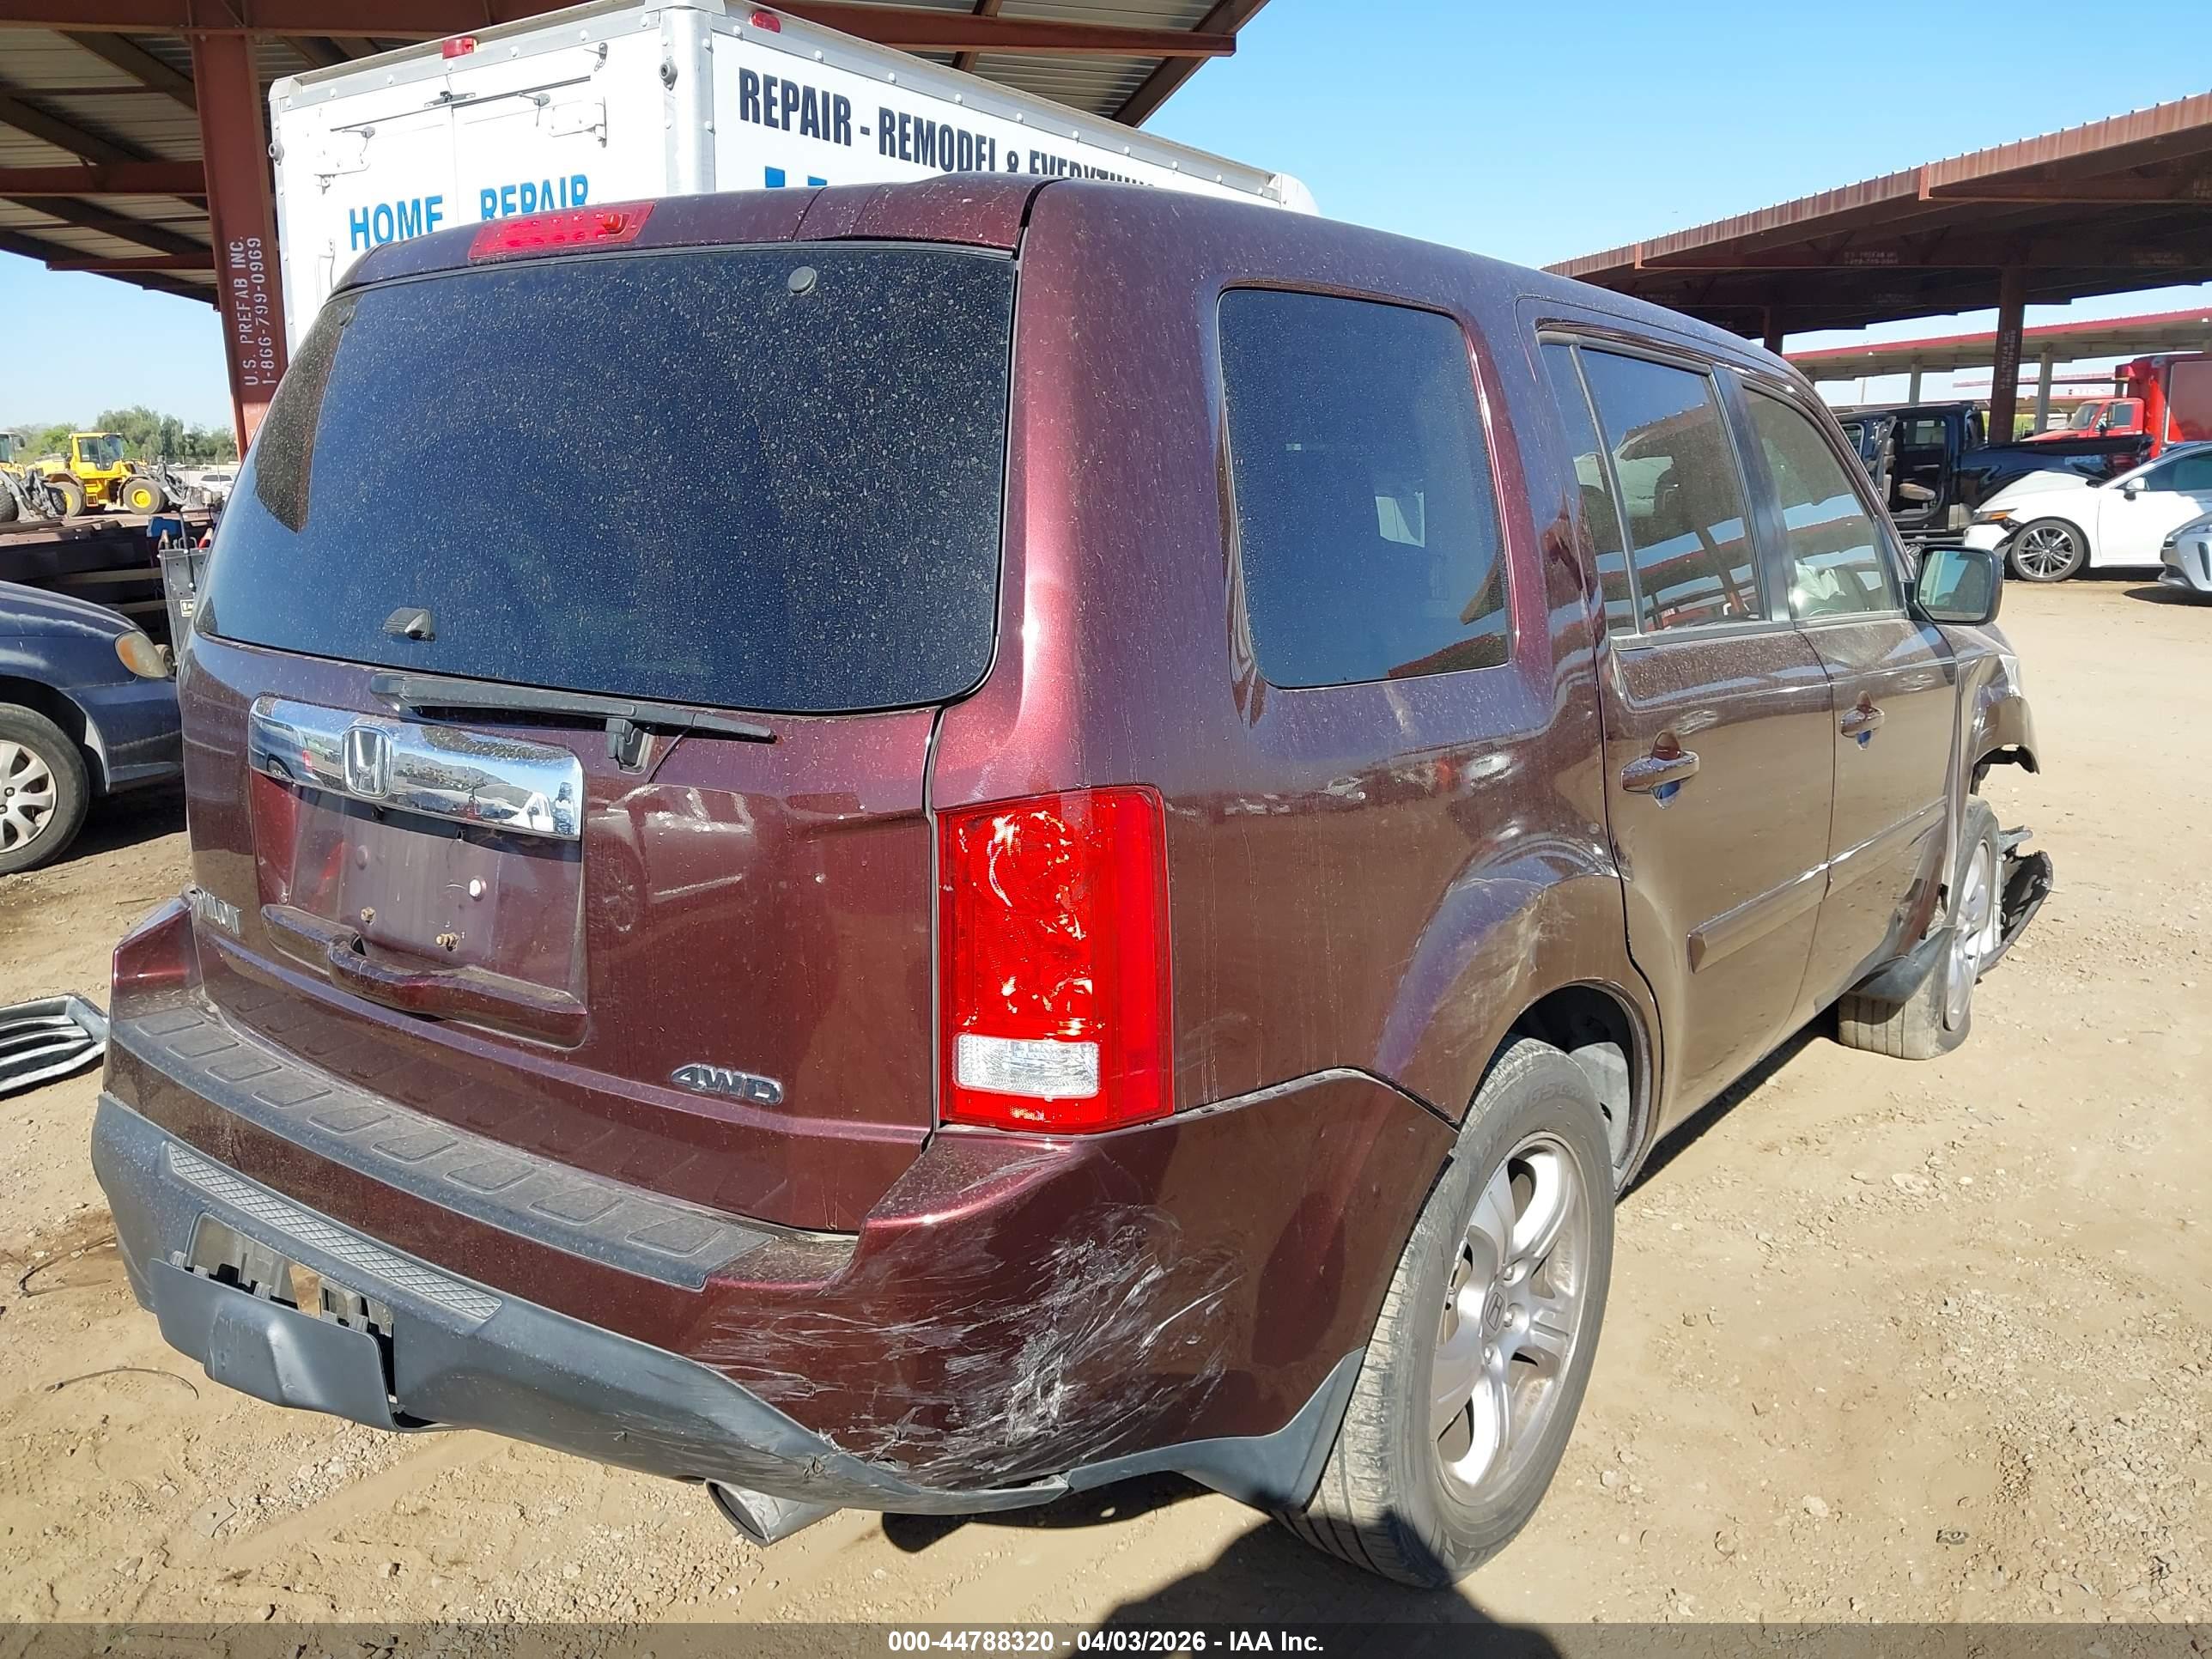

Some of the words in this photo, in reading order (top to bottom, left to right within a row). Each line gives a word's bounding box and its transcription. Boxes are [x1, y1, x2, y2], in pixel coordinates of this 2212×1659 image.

[738, 67, 852, 147] REPAIR
[860, 125, 871, 137] -
[878, 106, 996, 173] REMODEL
[349, 194, 443, 252] HOME
[480, 173, 588, 221] REPAIR
[229, 236, 246, 269] INC.
[234, 277, 255, 343] PREFAB
[246, 237, 277, 385] 1-866-799-0969
[242, 354, 259, 386] U.S.
[672, 1063, 783, 1105] 4WD
